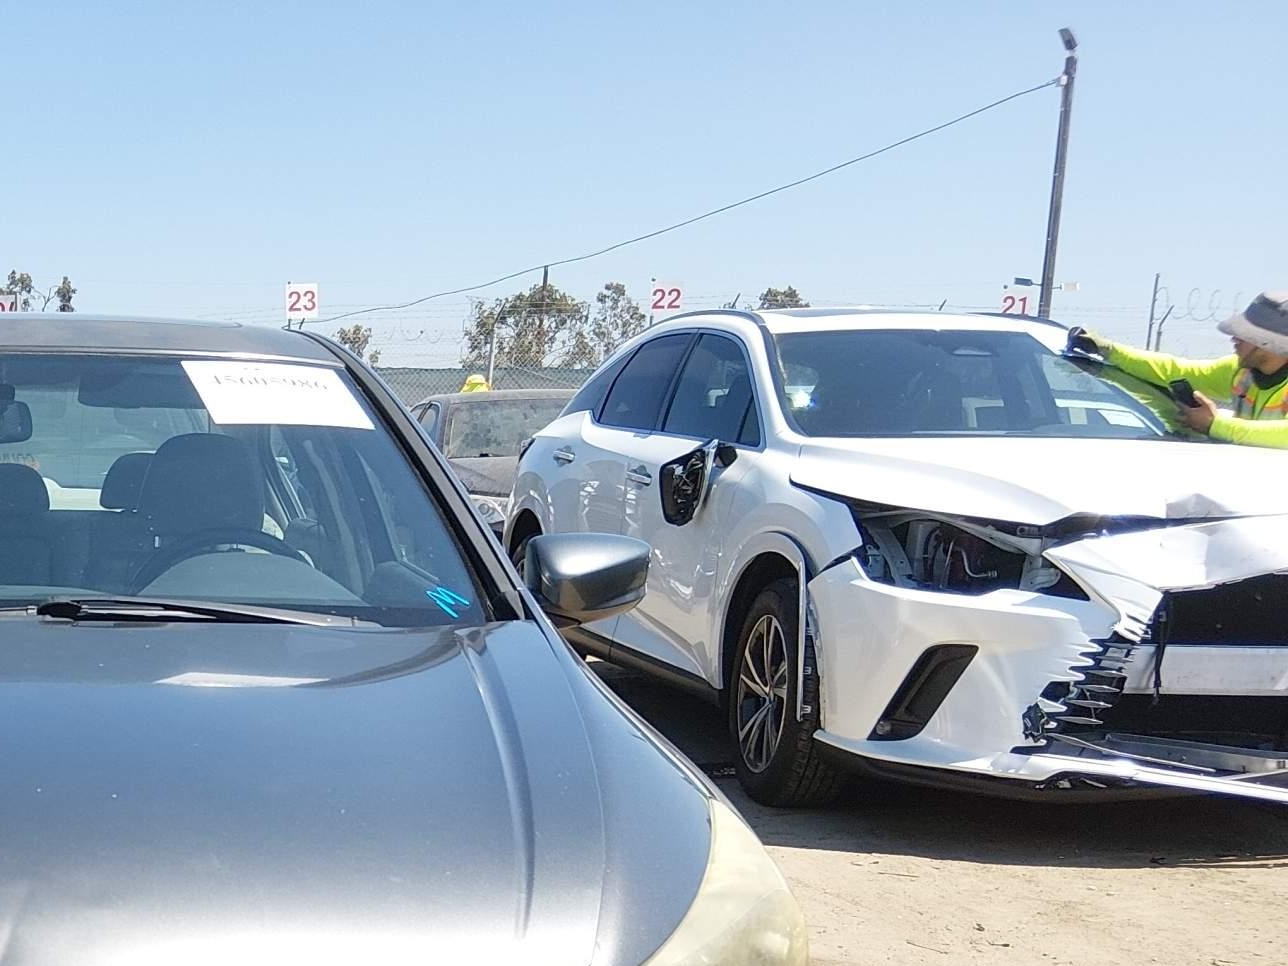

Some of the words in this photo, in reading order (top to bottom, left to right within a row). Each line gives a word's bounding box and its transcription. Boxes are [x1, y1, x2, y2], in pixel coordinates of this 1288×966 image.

[288, 290, 316, 312] 23
[652, 288, 681, 309] 22
[1003, 295, 1028, 315] 21
